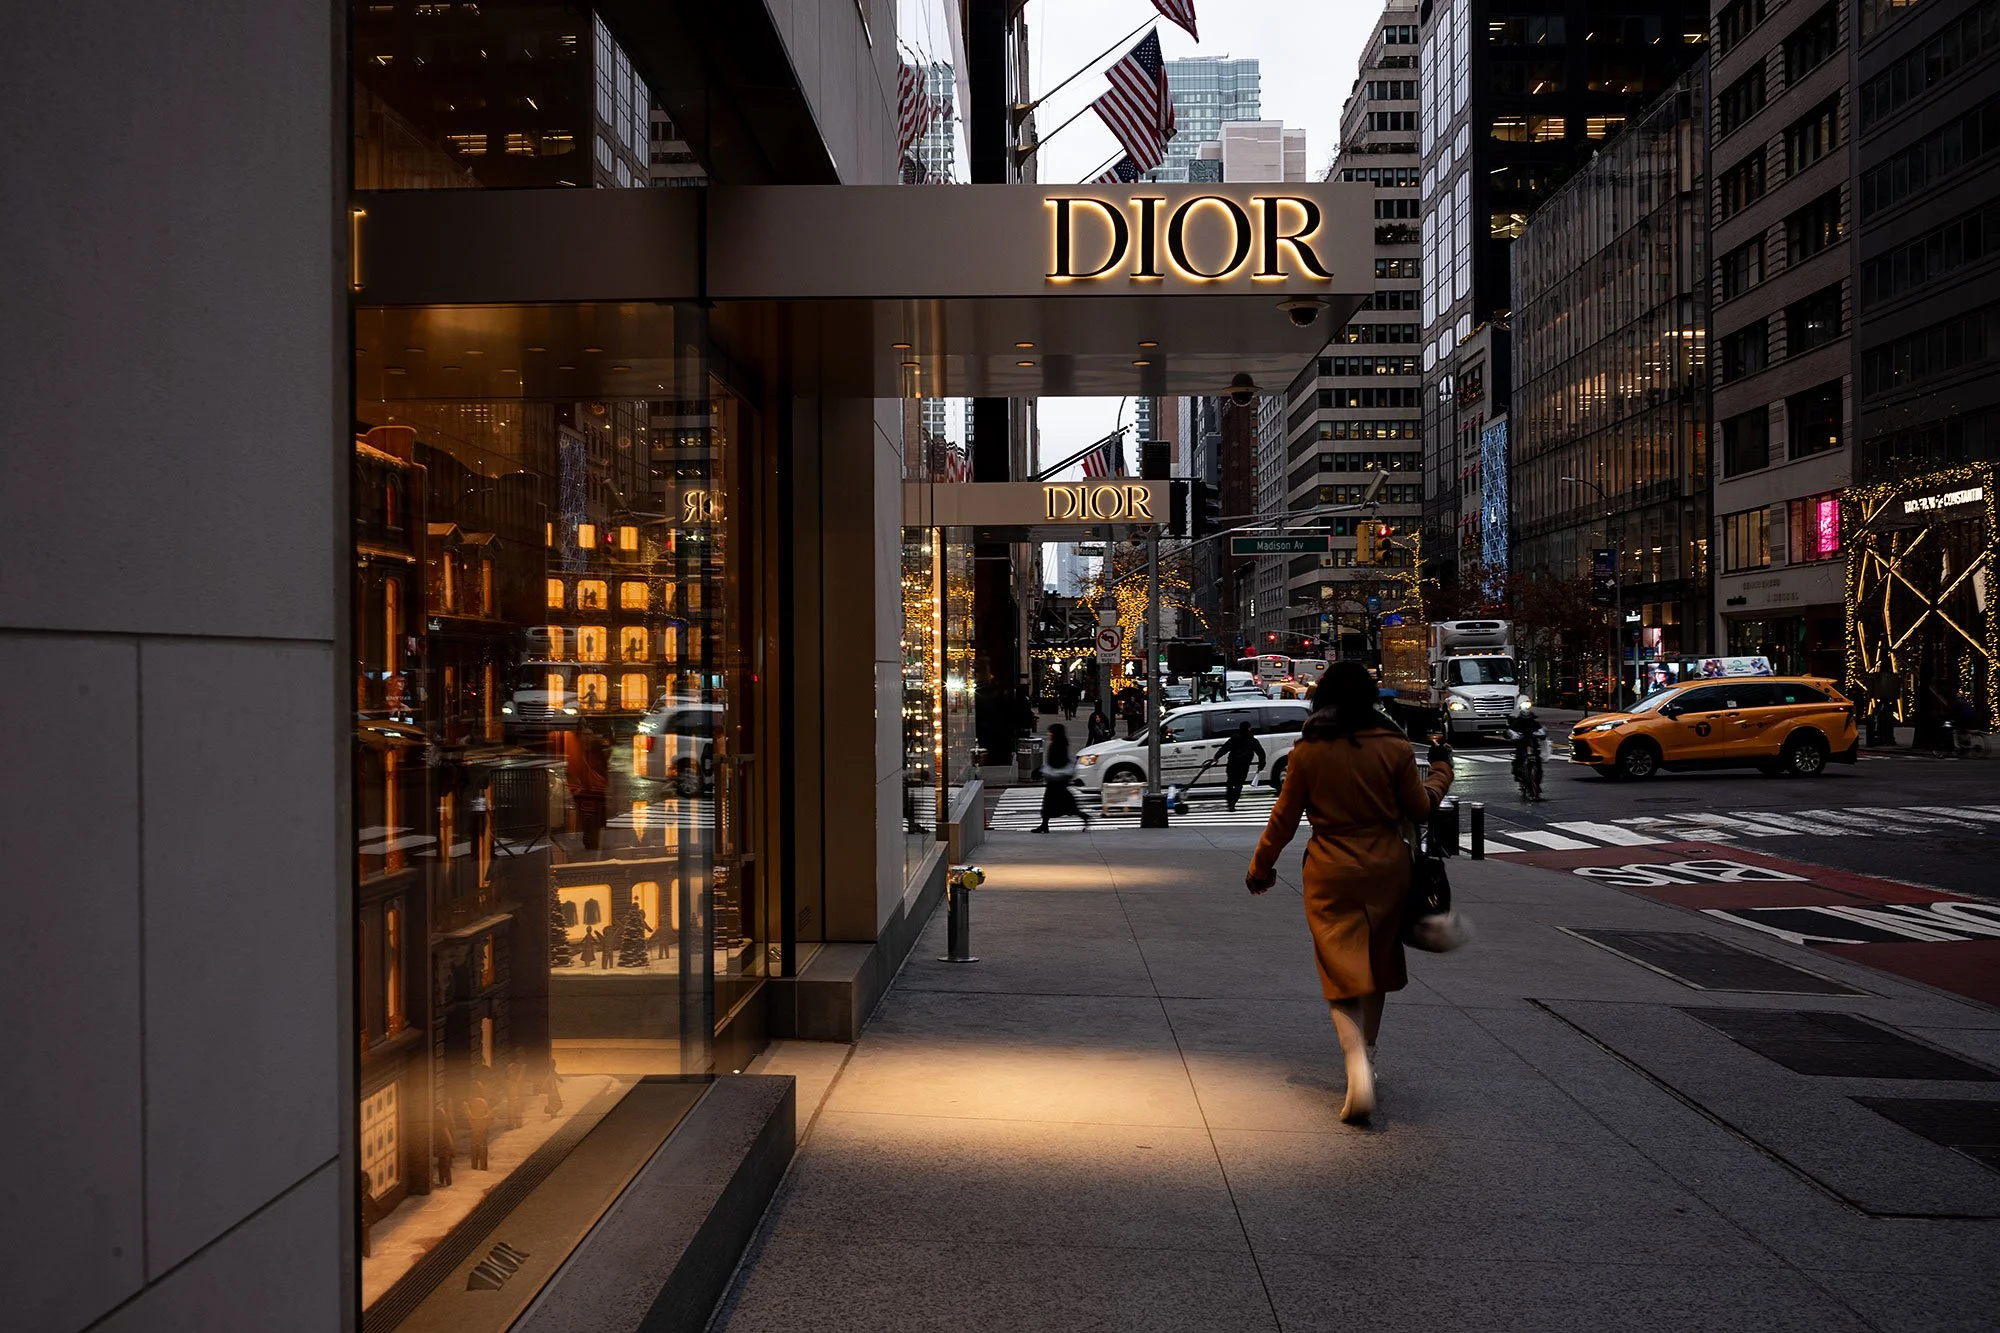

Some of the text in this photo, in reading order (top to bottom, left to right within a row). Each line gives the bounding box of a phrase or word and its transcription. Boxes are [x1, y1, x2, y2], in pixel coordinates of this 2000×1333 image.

[1045, 196, 1334, 279] DIOR
[1044, 485, 1154, 519] DIOR
[1257, 540, 1304, 551] Madison Av
[1572, 859, 1812, 887] BUS
[466, 1242, 530, 1292] DIOR
